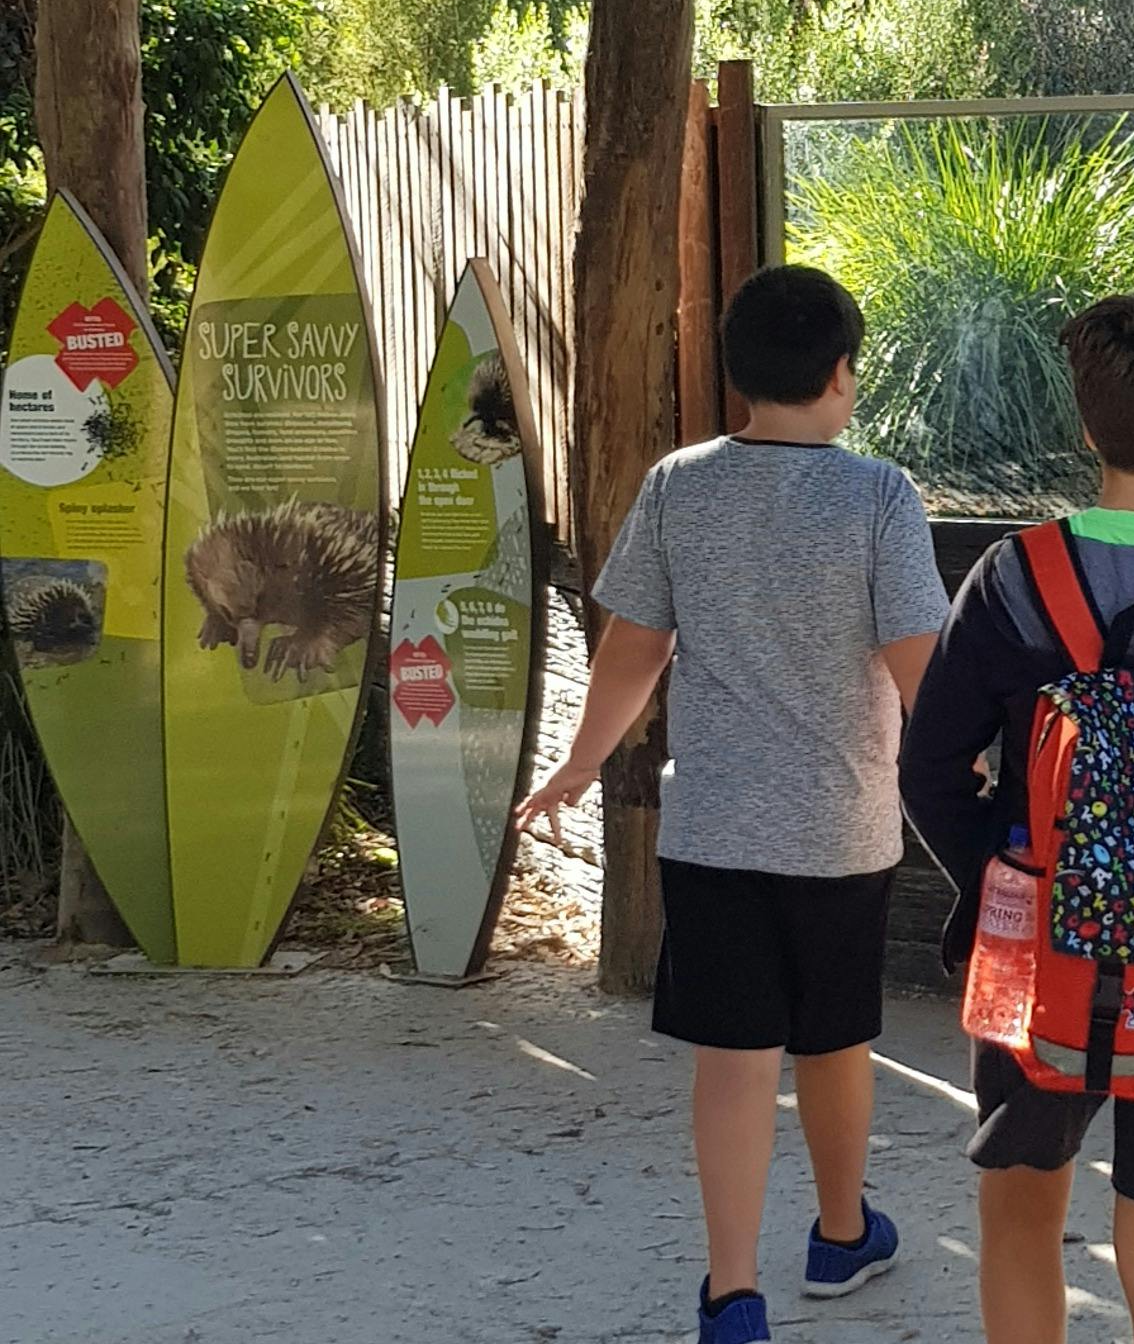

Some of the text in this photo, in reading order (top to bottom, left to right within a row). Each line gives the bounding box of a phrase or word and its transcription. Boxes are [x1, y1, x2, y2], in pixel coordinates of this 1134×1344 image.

[66, 332, 125, 351] BUSTED
[199, 321, 359, 359] SUPER SAVVY
[42, 389, 53, 400] of
[400, 664, 444, 682] BUSTED
